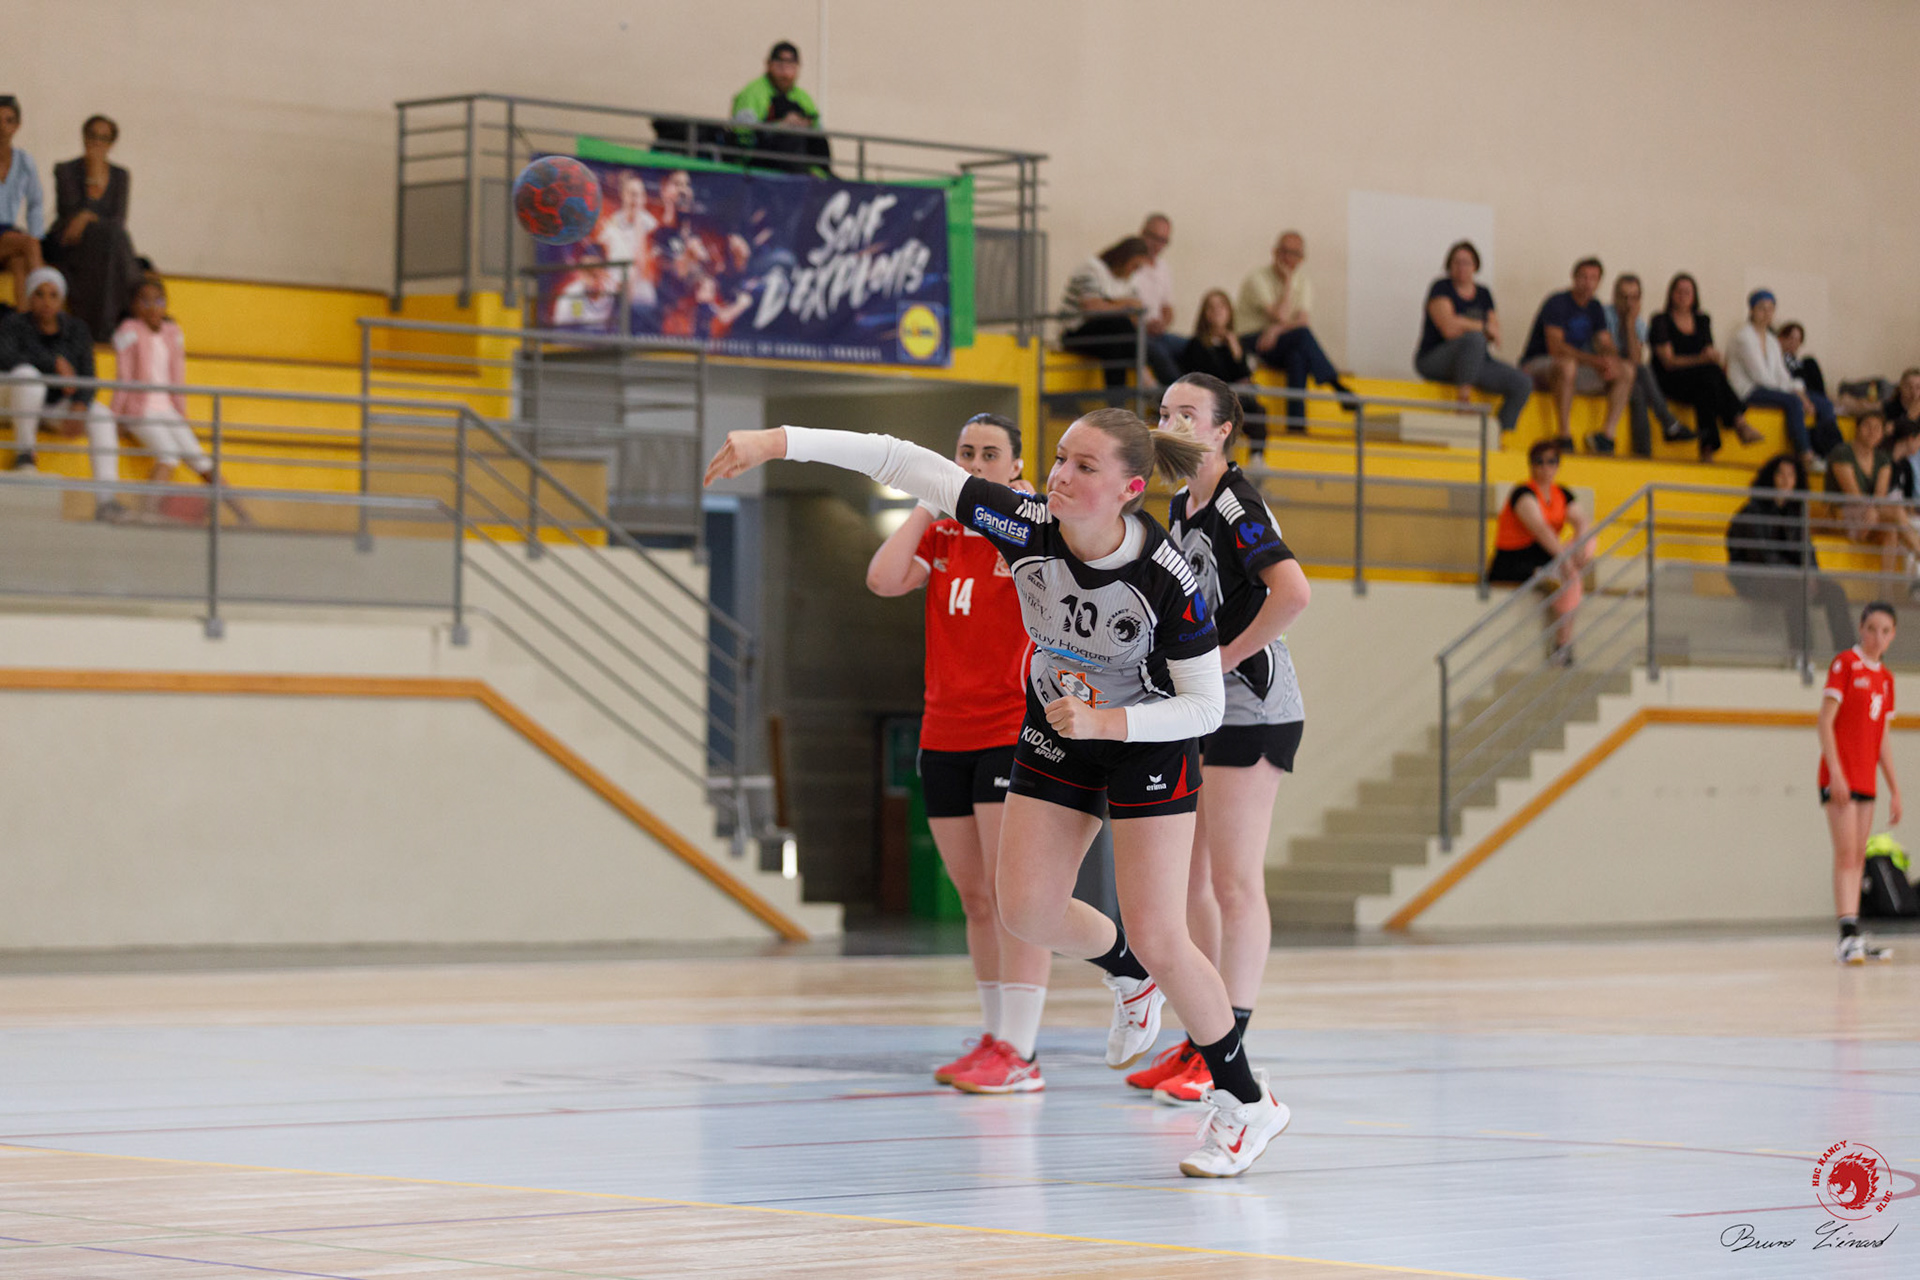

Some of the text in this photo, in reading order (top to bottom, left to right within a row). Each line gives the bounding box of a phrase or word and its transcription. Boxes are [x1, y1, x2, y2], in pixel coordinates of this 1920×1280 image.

[948, 577, 975, 616] 14
[1060, 594, 1098, 638] 10
[1034, 747, 1064, 763] SPORT
[1146, 783, 1167, 791] erima
